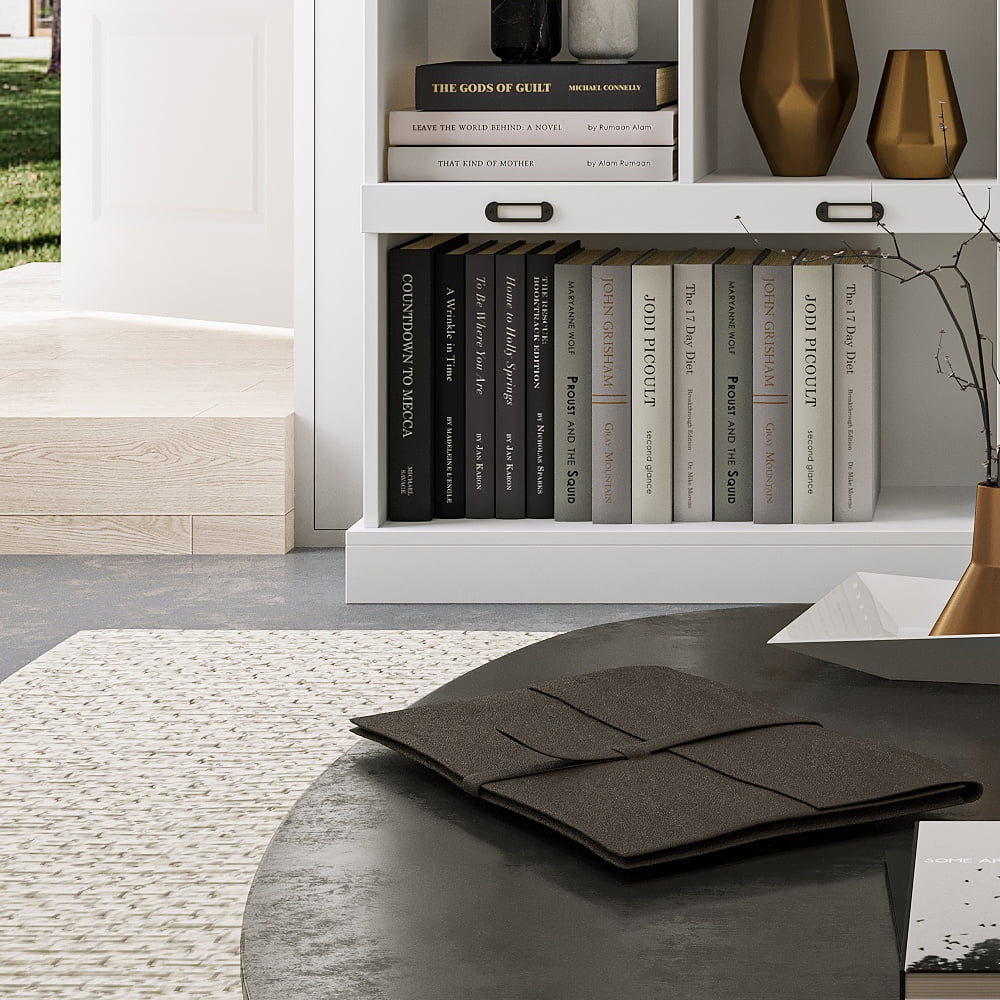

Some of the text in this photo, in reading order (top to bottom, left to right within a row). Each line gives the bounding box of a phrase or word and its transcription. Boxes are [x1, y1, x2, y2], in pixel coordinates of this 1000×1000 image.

[432, 84, 551, 93] THE GODS OF GUILT
[446, 300, 455, 340] Wrinkle
[507, 276, 515, 309] Home
[507, 313, 513, 322] to
[601, 278, 613, 387] JOHN GRISHAM
[686, 284, 695, 374] The 17 Day Diet
[402, 274, 413, 438] COUNTDOWN TO MECCA
[446, 344, 455, 352] in
[446, 355, 455, 381] Time
[476, 277, 486, 395] To Be Where You Are
[503, 326, 516, 406] Holly Springs
[644, 294, 655, 407] JODI PICOULT
[567, 376, 578, 504] PROUST AND THE SQUID
